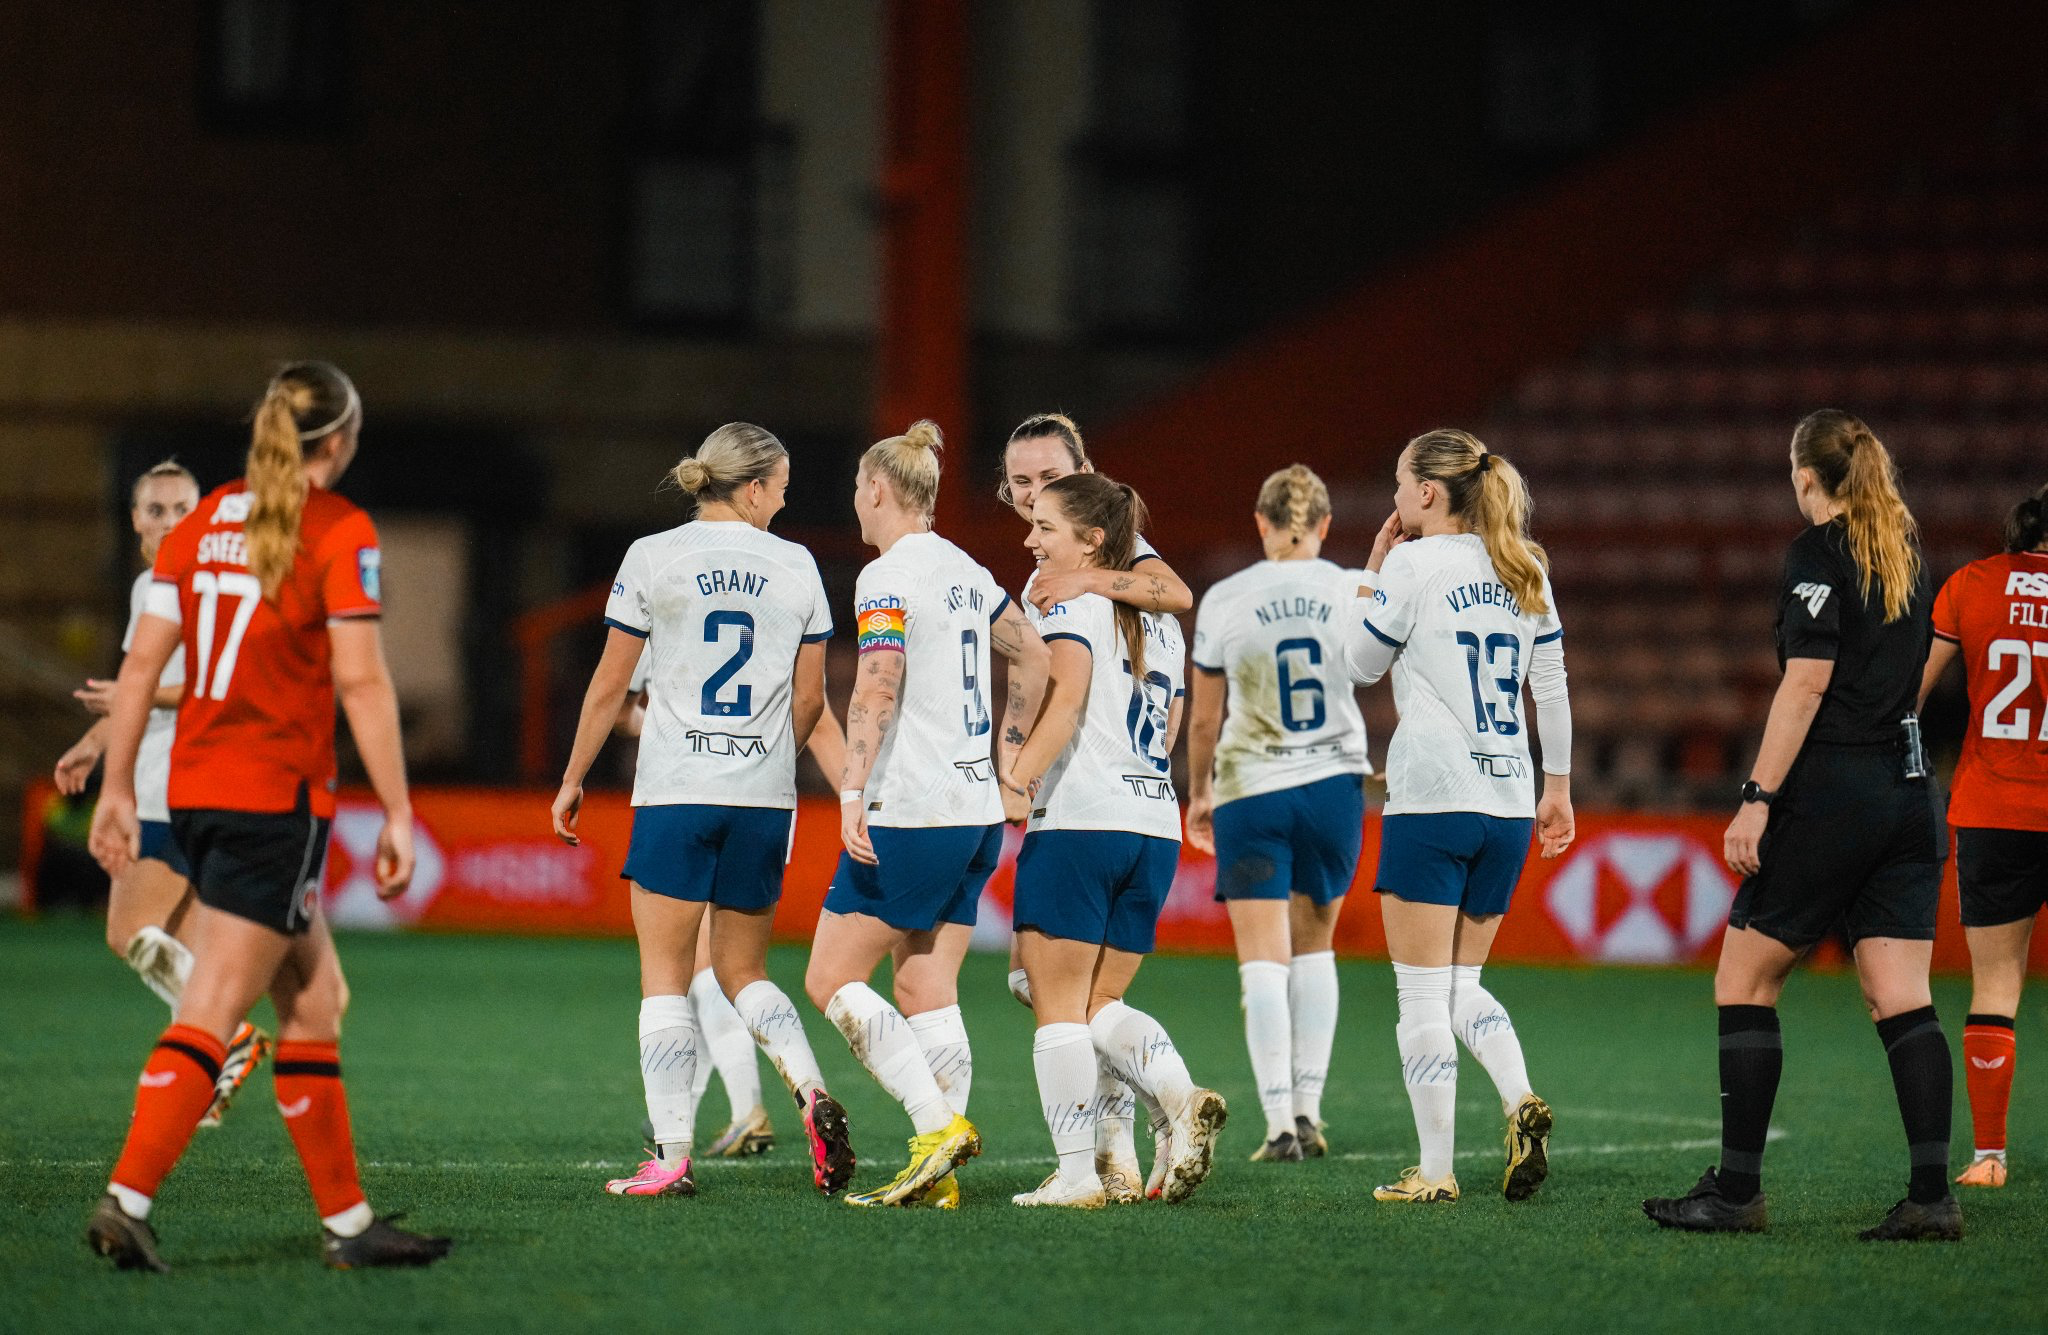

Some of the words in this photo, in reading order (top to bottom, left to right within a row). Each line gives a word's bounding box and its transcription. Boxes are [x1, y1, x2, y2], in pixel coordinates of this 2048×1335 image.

[696, 569, 768, 598] GRANT
[2005, 571, 2048, 598] RS
[1255, 597, 1332, 626] NILDEN
[193, 571, 261, 701] 17
[860, 636, 902, 650] CAPTAIN
[701, 610, 755, 717] 2
[1276, 637, 1326, 733] 6
[1456, 631, 1520, 736] 13
[686, 729, 767, 757] TUMI
[1470, 751, 1527, 778] TUMI
